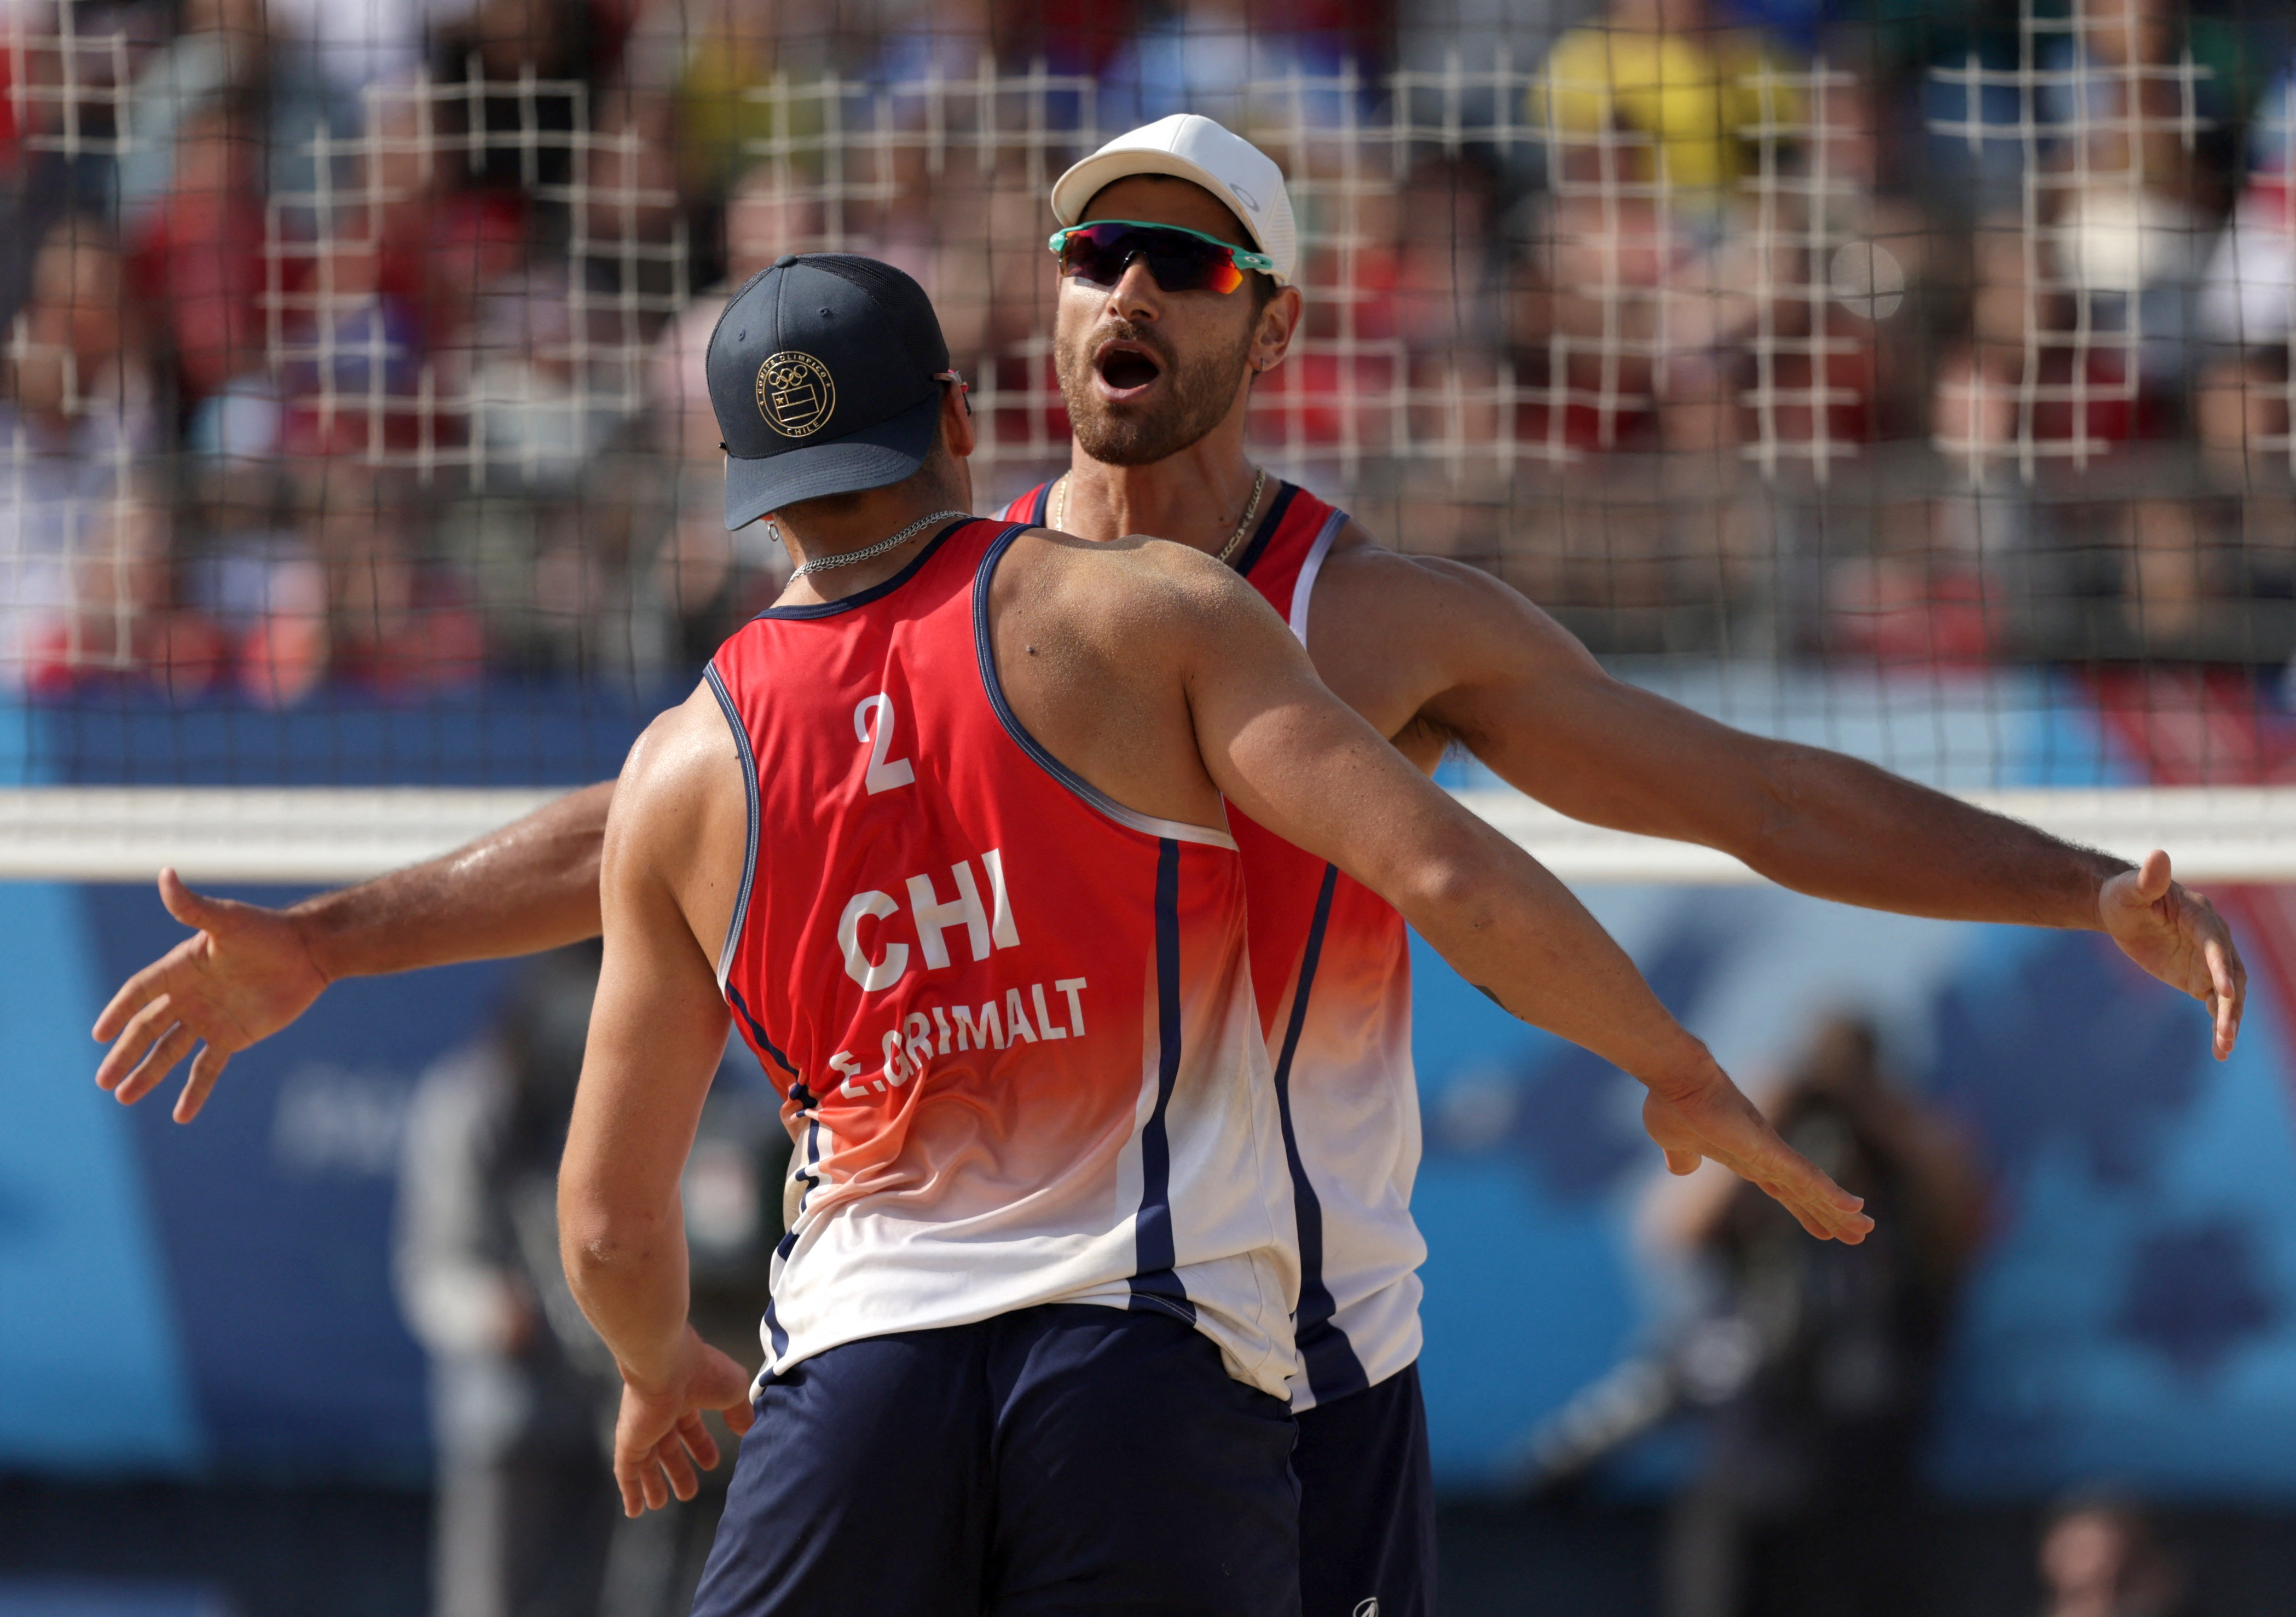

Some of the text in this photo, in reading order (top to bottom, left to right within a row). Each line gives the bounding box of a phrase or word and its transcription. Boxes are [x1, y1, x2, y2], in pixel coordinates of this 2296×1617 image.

[758, 354, 827, 394] COMITE OLIMPICO
[786, 421, 820, 436] CHILE
[853, 691, 915, 796] 2
[837, 848, 1021, 992] CHI
